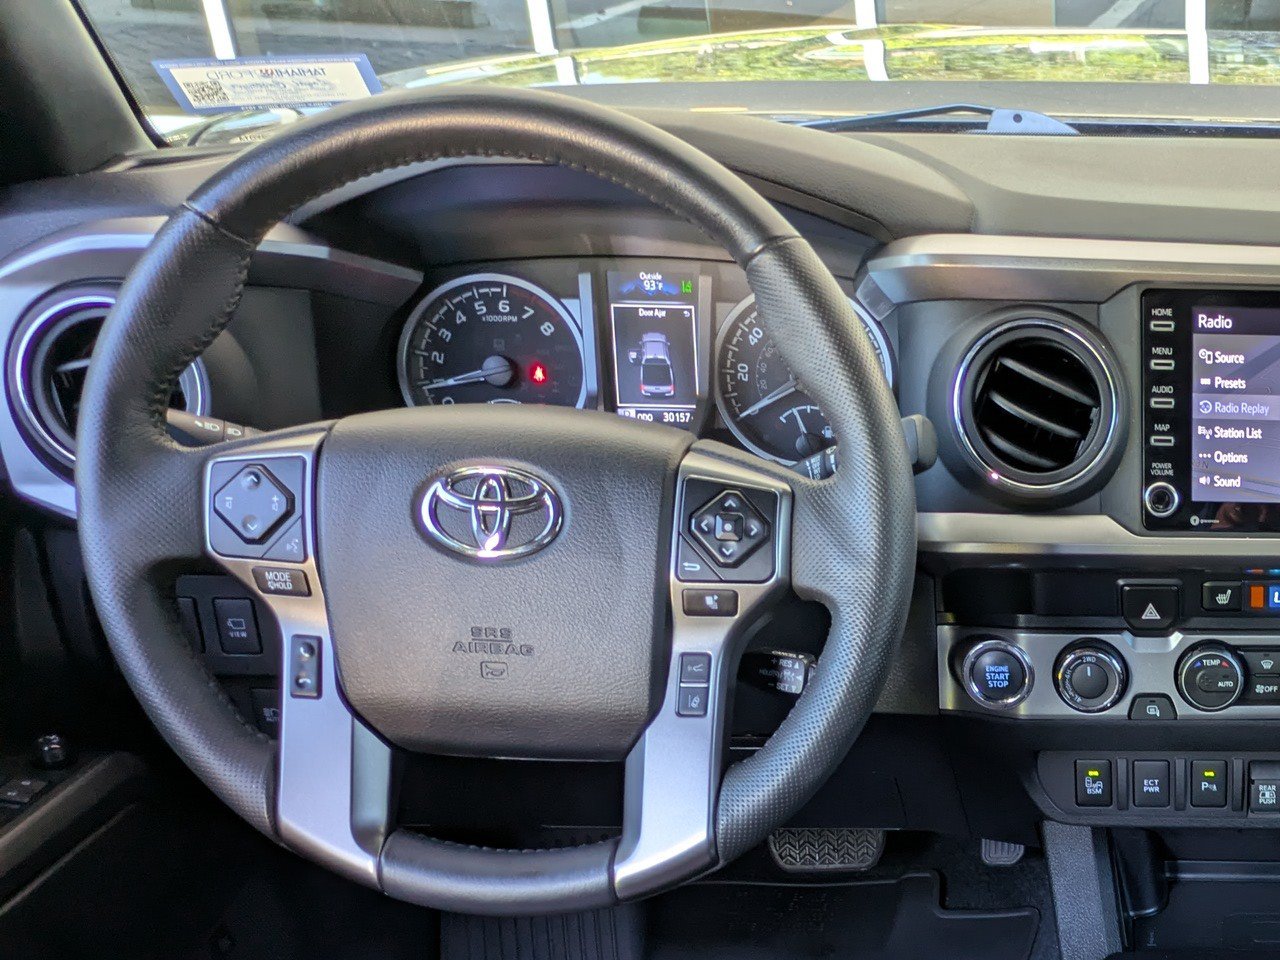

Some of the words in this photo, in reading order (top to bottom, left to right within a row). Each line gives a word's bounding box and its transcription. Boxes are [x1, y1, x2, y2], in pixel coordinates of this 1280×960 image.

[639, 271, 662, 281] Outside
[474, 301, 487, 315] 5
[498, 300, 511, 312] 6
[455, 310, 467, 324] 4
[521, 305, 535, 319] 7
[638, 308, 654, 318] Door
[1151, 308, 1173, 317] HOME
[1198, 313, 1233, 329] Radio
[540, 321, 555, 336] 8
[438, 328, 452, 342] 3
[748, 327, 763, 346] 40
[1151, 347, 1173, 356] MENU
[1214, 350, 1245, 364] Source
[431, 351, 444, 364] 2
[737, 363, 749, 382] 20
[1214, 376, 1247, 389] Presets
[1151, 386, 1174, 394] AUDIO
[1214, 401, 1240, 414] Radio
[1241, 402, 1270, 417] Replay
[663, 412, 691, 423] 30157
[1154, 423, 1170, 432] MAP
[1214, 425, 1245, 439] Station
[1245, 426, 1263, 439] List
[1213, 450, 1249, 466] Options
[1150, 468, 1174, 476] VOLUME
[1213, 475, 1241, 488] Sound
[265, 571, 292, 582] MODE
[274, 581, 293, 590] HOLD
[470, 626, 513, 640] SRS
[452, 641, 535, 656] AIRBAG
[1202, 659, 1221, 667] TEMP
[985, 672, 1010, 680] START
[988, 680, 1009, 688] STOP
[1217, 680, 1234, 688] AUTO
[1264, 685, 1279, 693] OFF
[1143, 778, 1159, 786] ECT
[1086, 787, 1103, 795] BSM
[1143, 785, 1160, 793] PWR
[1258, 784, 1277, 792] REAR
